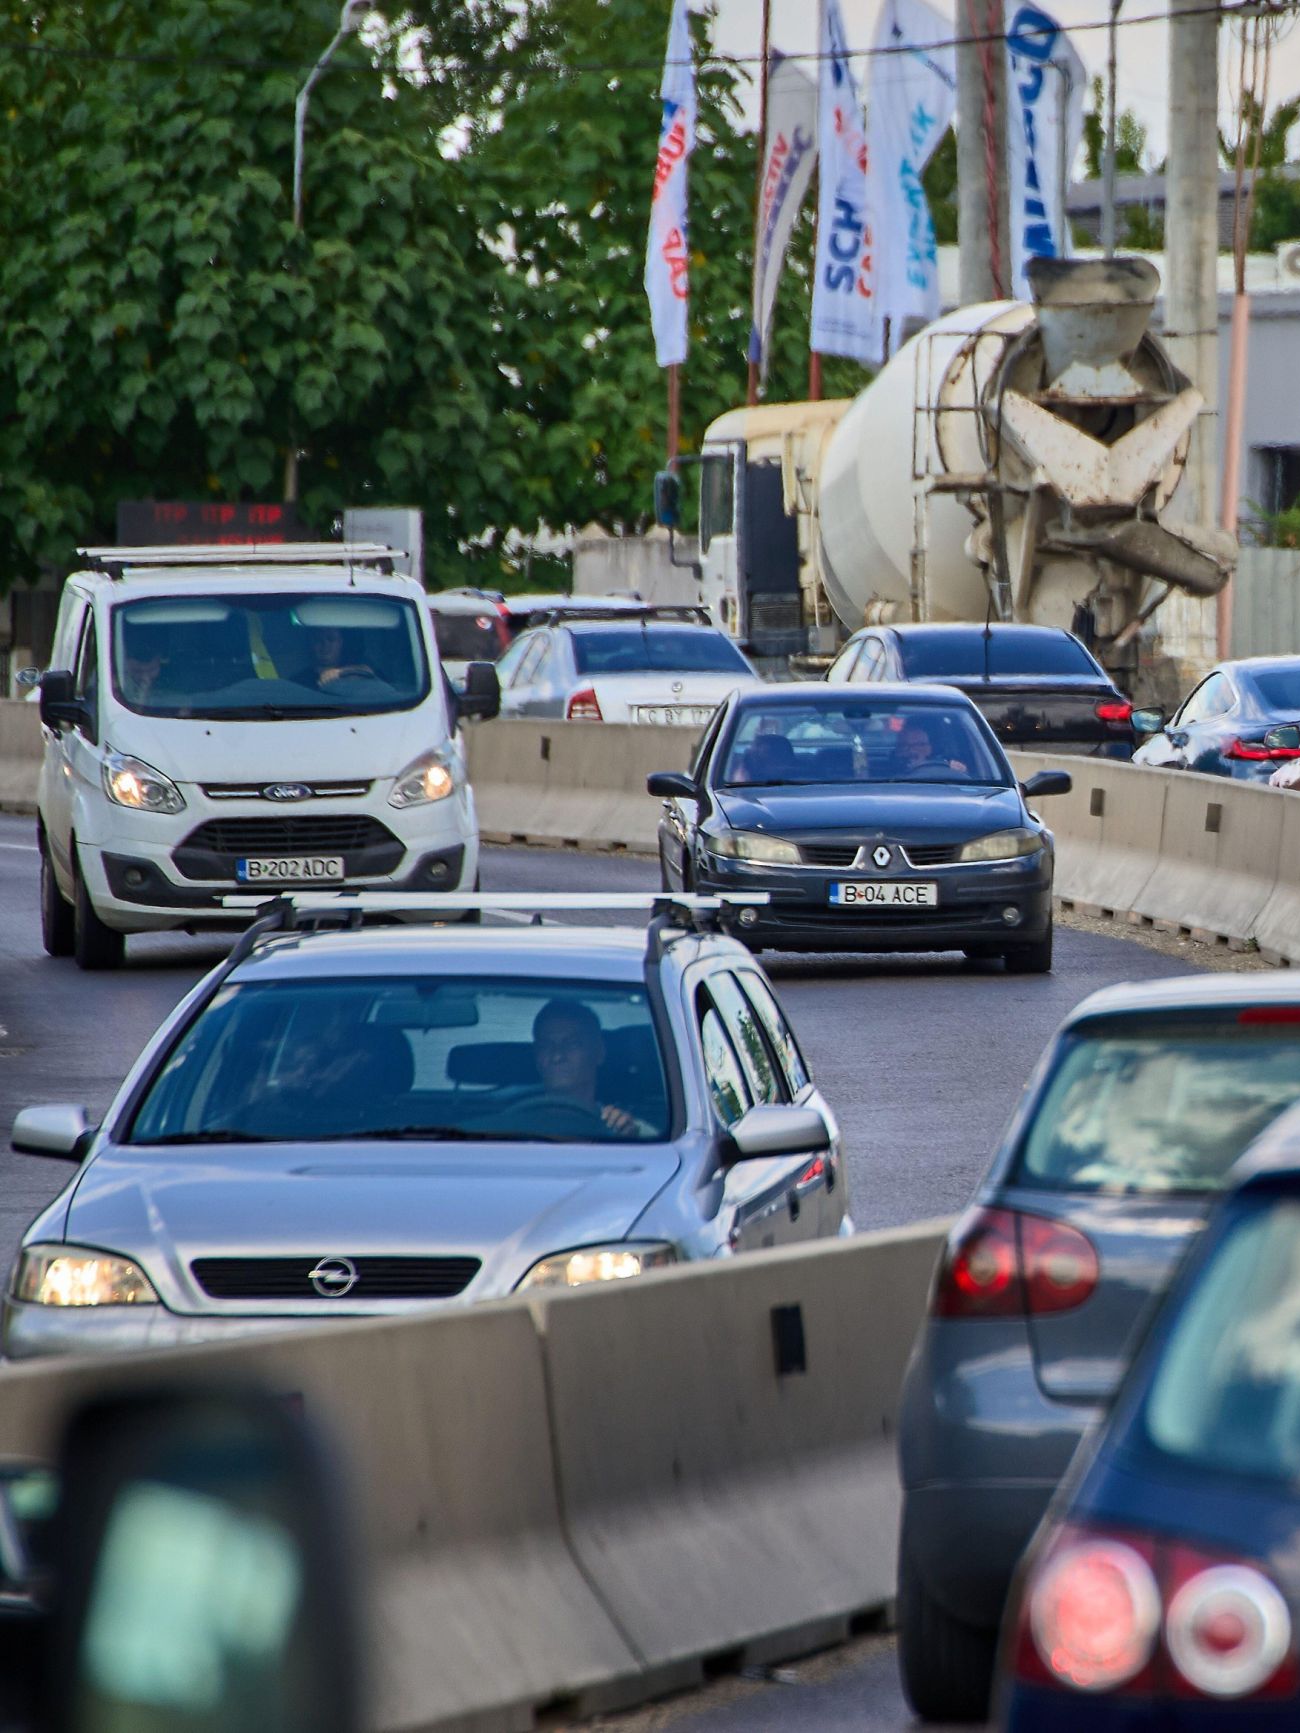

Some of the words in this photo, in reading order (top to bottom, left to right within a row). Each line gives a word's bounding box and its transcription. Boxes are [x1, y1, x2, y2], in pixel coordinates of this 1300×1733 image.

[249, 861, 261, 877] B
[268, 861, 299, 877] 202
[303, 860, 338, 877] ADC
[845, 886, 857, 903] B
[864, 886, 885, 902] 04
[892, 886, 928, 903] ACE
